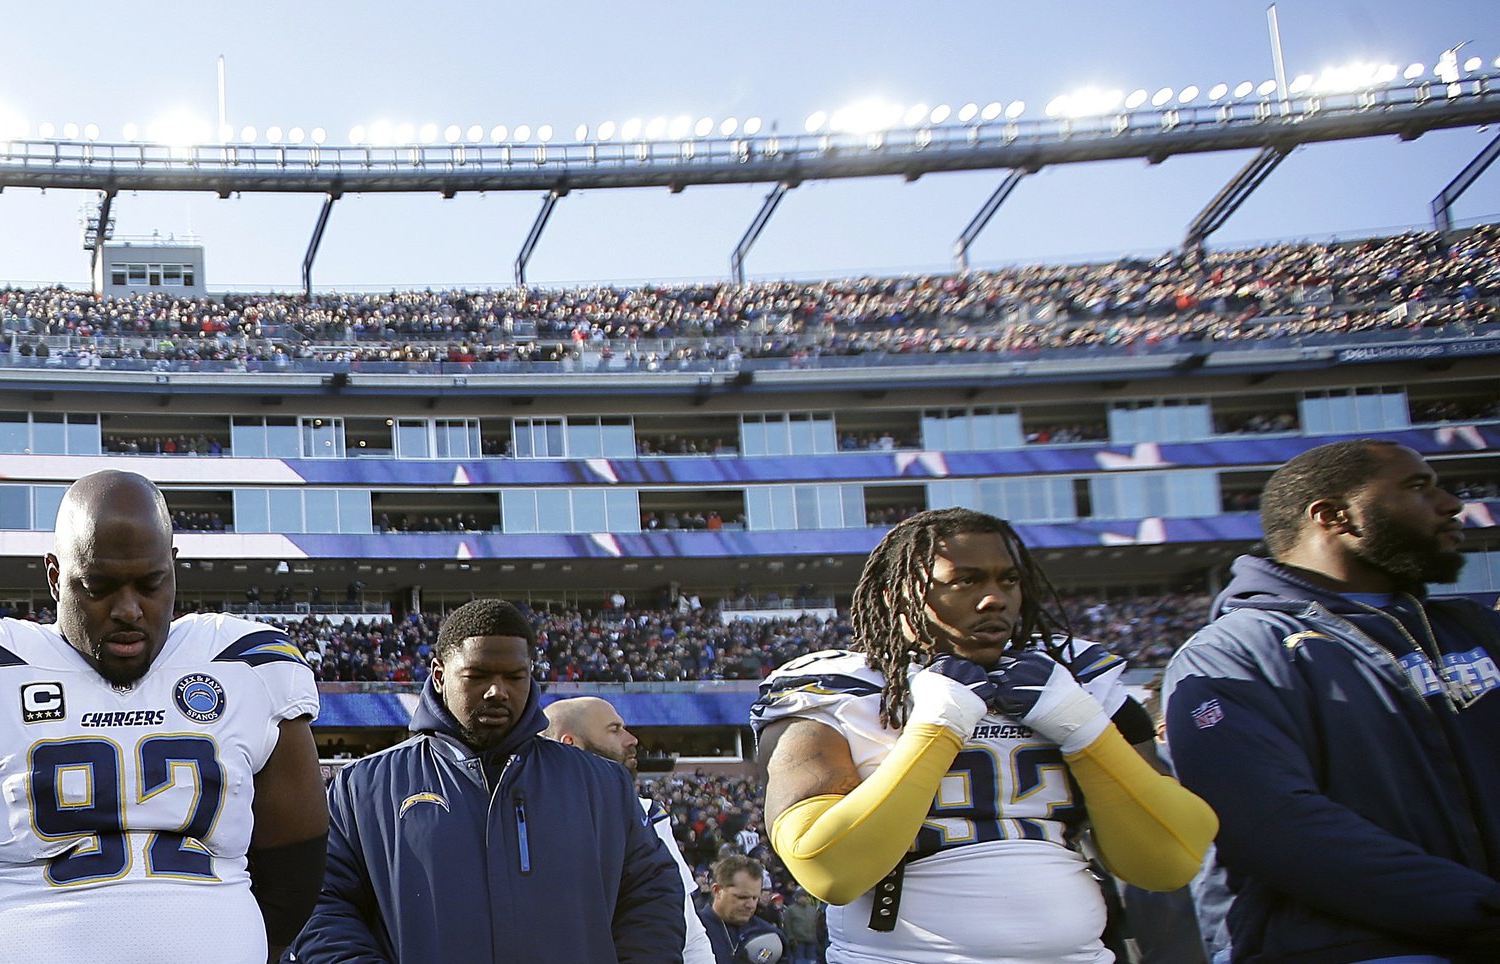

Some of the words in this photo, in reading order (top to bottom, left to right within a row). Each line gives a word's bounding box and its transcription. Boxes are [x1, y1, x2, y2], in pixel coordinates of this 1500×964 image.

[177, 675, 197, 692] ALEX
[24, 684, 63, 712] C
[80, 709, 166, 728] CHARGERS
[186, 709, 219, 721] SPANOS
[26, 731, 228, 888] 92
